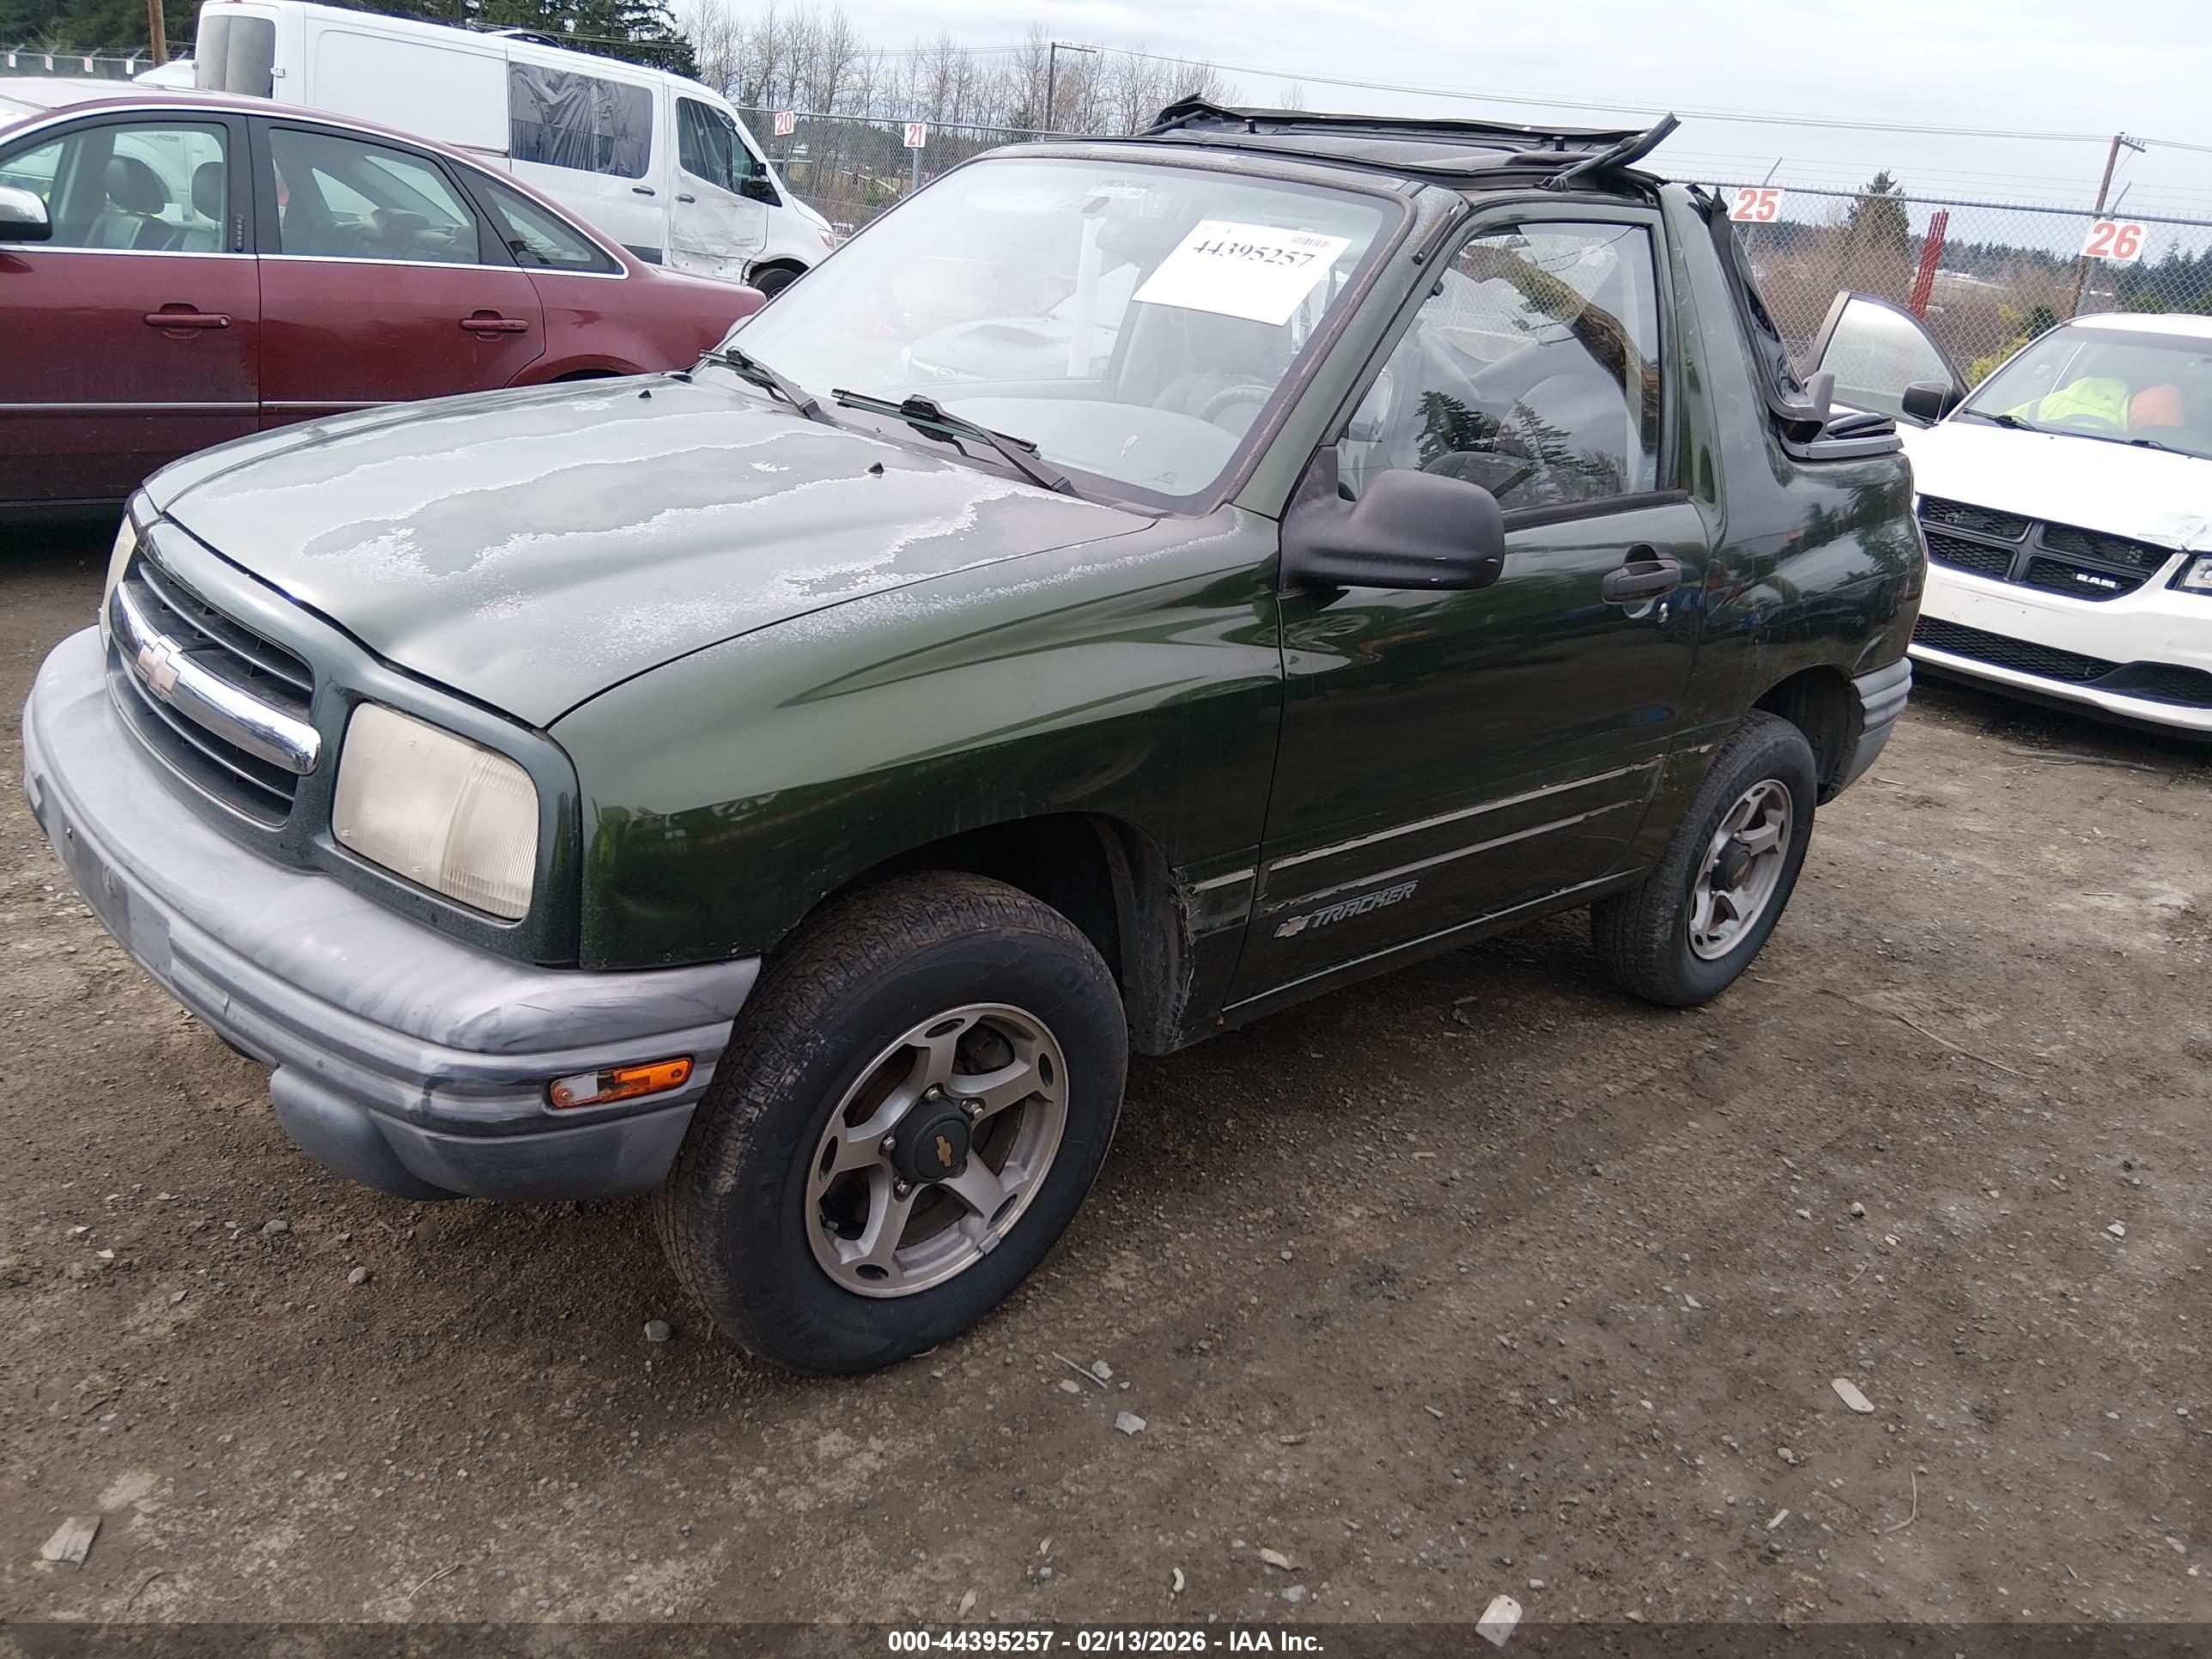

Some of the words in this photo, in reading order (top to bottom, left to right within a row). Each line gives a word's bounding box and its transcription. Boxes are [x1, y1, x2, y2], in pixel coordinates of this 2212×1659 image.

[776, 112, 792, 134] 20
[907, 124, 922, 146] 21
[1734, 189, 1778, 221] 25
[1194, 240, 1316, 268] 44395257
[2086, 222, 2142, 258] 26
[2075, 573, 2117, 589] RAM
[1311, 879, 1419, 928] TRACKER
